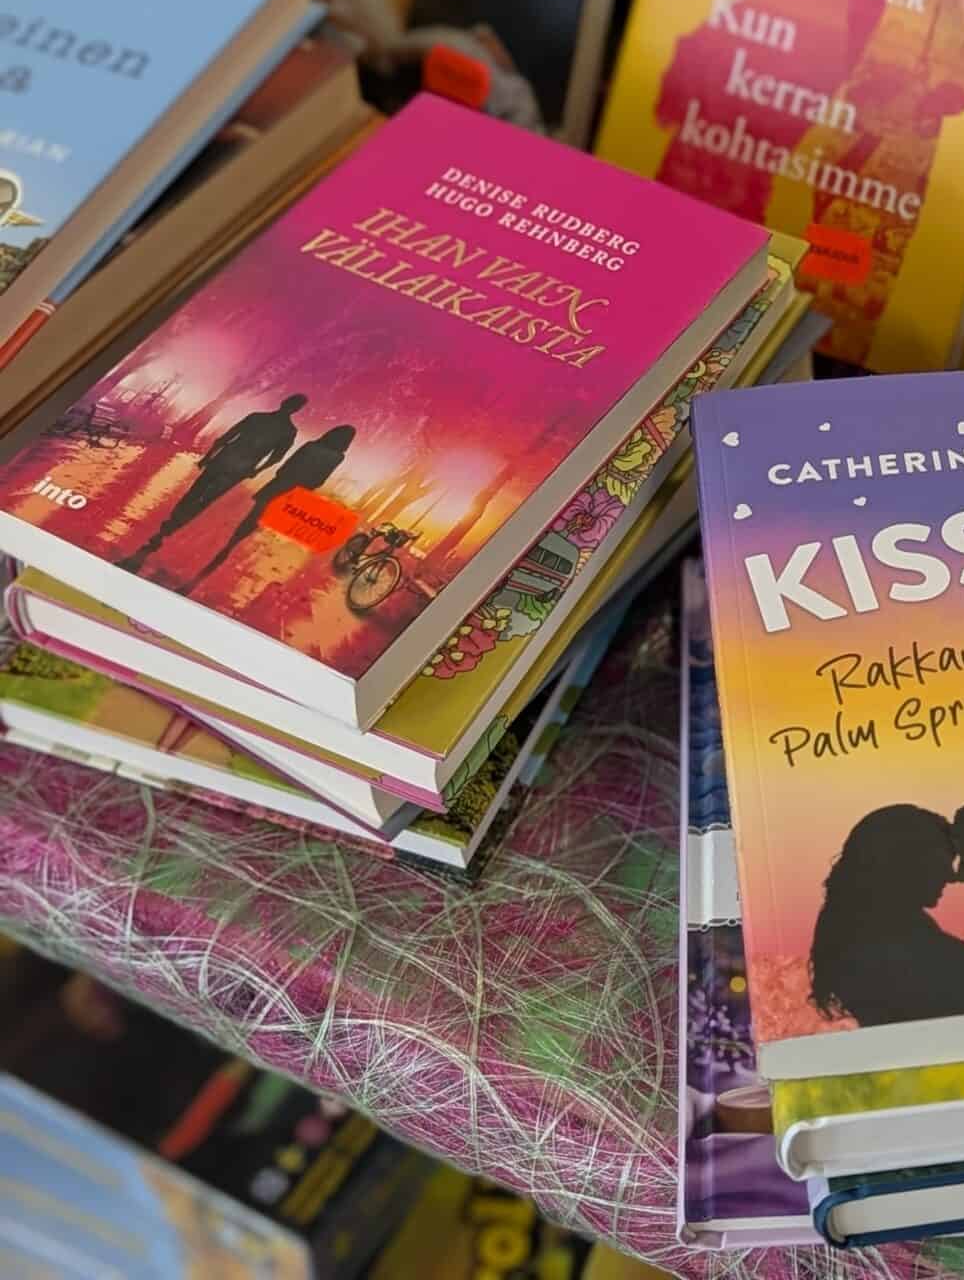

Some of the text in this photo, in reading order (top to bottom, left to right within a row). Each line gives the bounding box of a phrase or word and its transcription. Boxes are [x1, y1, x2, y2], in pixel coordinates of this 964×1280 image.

[724, 49, 858, 136] kerran
[678, 102, 923, 224] kohtasimme
[424, 182, 626, 274] HUGO REHNBERG
[441, 167, 642, 258] DENISE RUDBERG
[298, 226, 606, 370] VÄLIAIKAISTA
[352, 208, 610, 338] IHAN VAIN
[31, 478, 88, 512] into
[282, 503, 337, 536] TARJOUS
[768, 710, 879, 768] Palm
